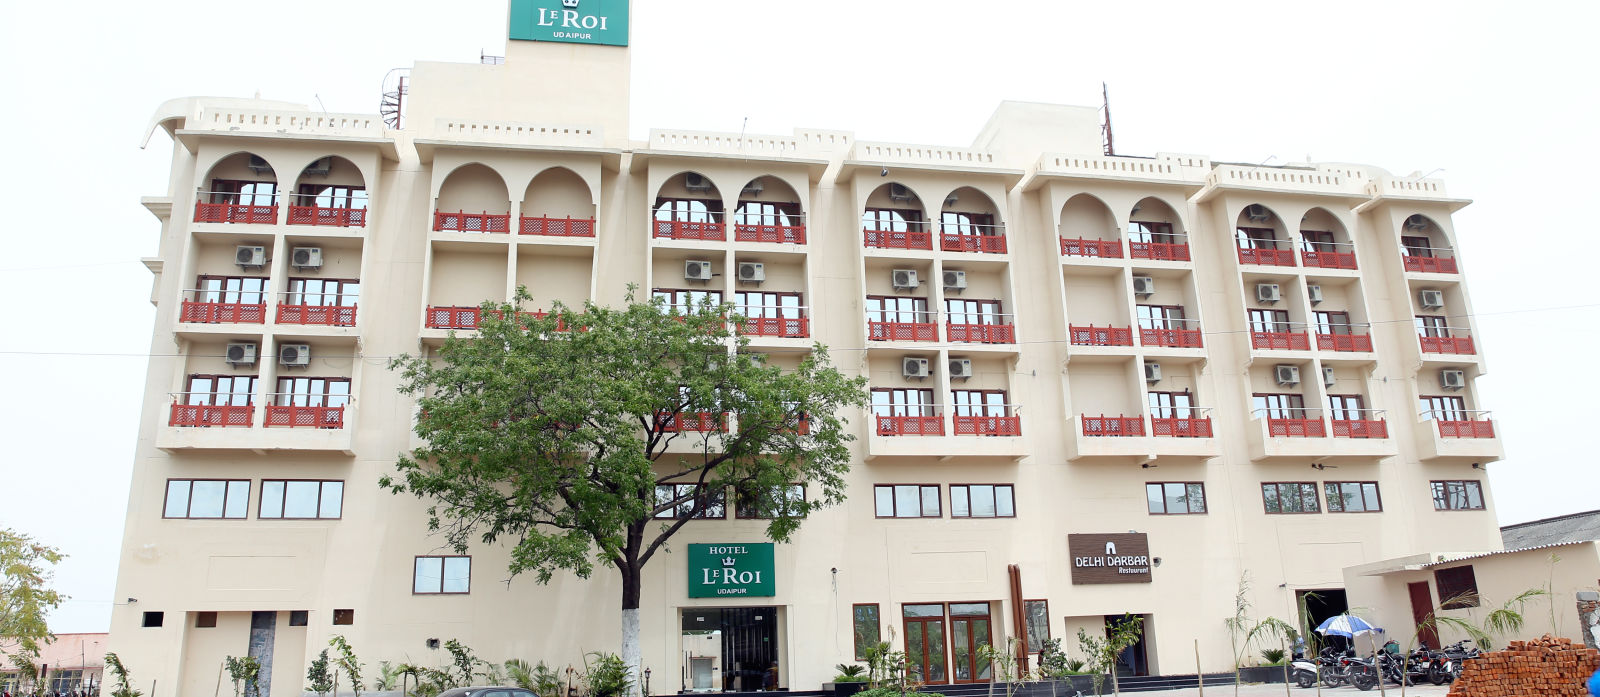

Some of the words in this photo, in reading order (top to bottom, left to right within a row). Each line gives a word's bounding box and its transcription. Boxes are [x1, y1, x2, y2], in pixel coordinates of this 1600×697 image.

[553, 31, 592, 40] UDAIPUR
[709, 546, 748, 555] HOTEL
[1075, 556, 1105, 567] DELHI
[1107, 555, 1149, 567] DARBAR
[1118, 566, 1149, 574] Restaurant
